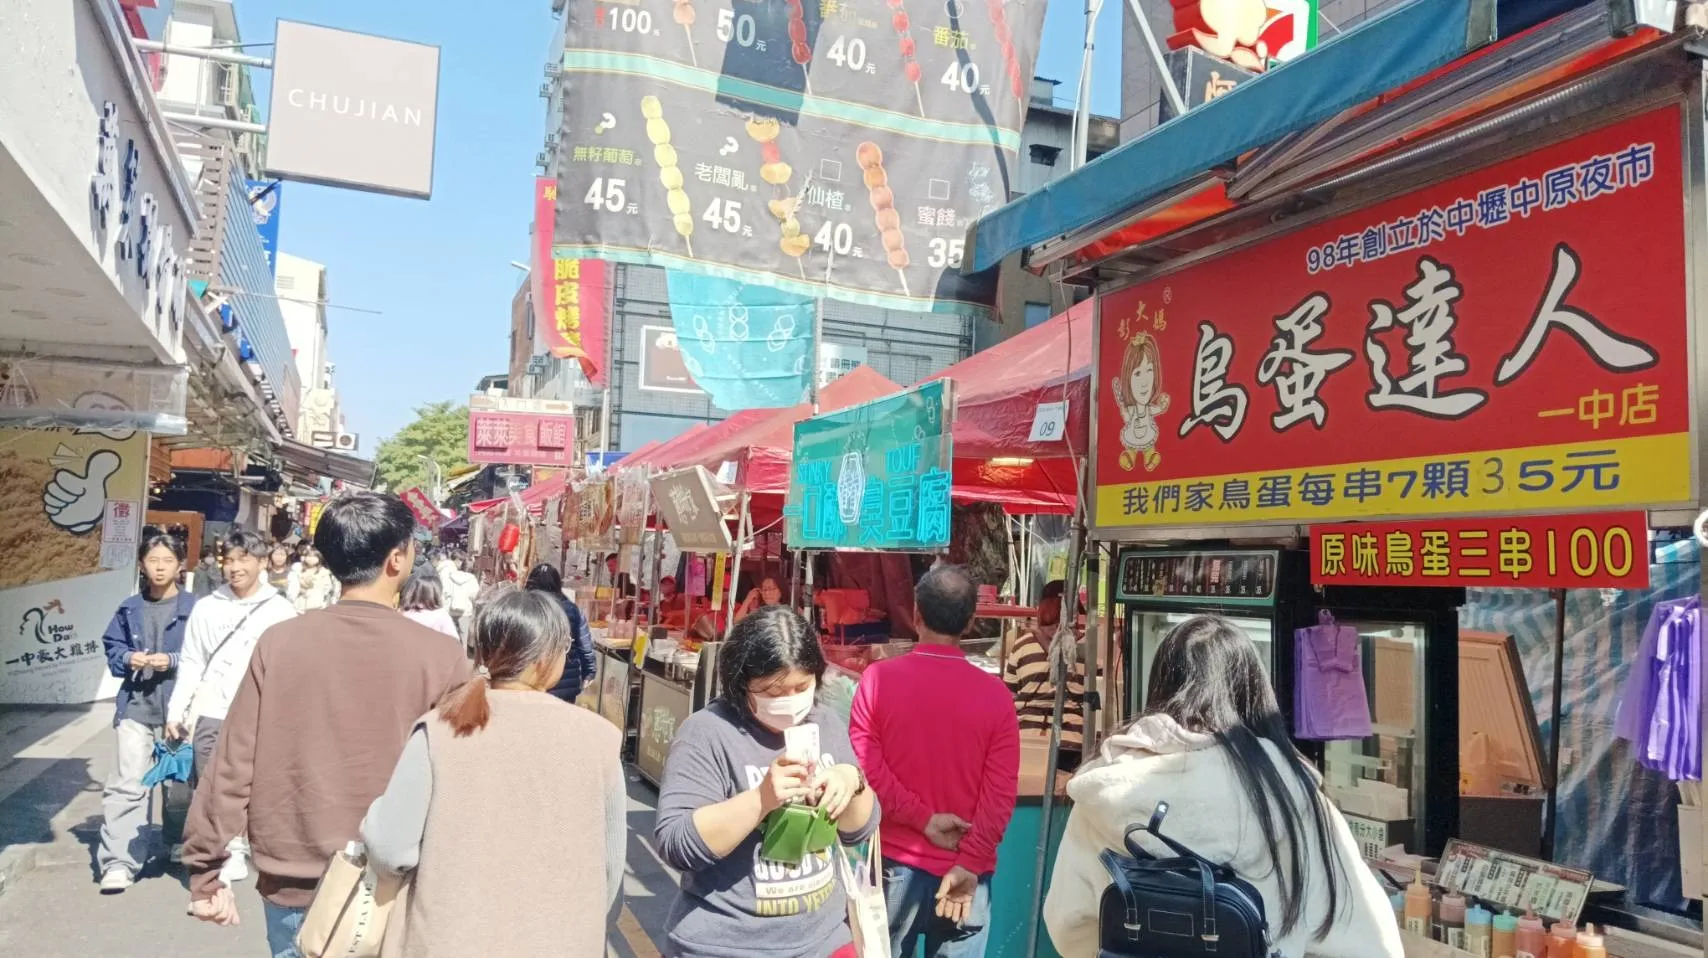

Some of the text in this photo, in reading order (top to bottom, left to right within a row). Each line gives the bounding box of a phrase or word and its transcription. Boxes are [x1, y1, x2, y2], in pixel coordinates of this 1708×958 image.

[288, 88, 422, 127] CHUJIAN
[1306, 143, 1655, 275] 98年創立於中壢中原夜市
[1178, 241, 1661, 442] 鳥蛋達人
[1039, 421, 1056, 437] 09
[1537, 383, 1660, 430] 一中店
[1123, 449, 1620, 516] 我們家鳥蛋每串7顆35元
[1319, 526, 1634, 580] 原味鳥蛋三串100
